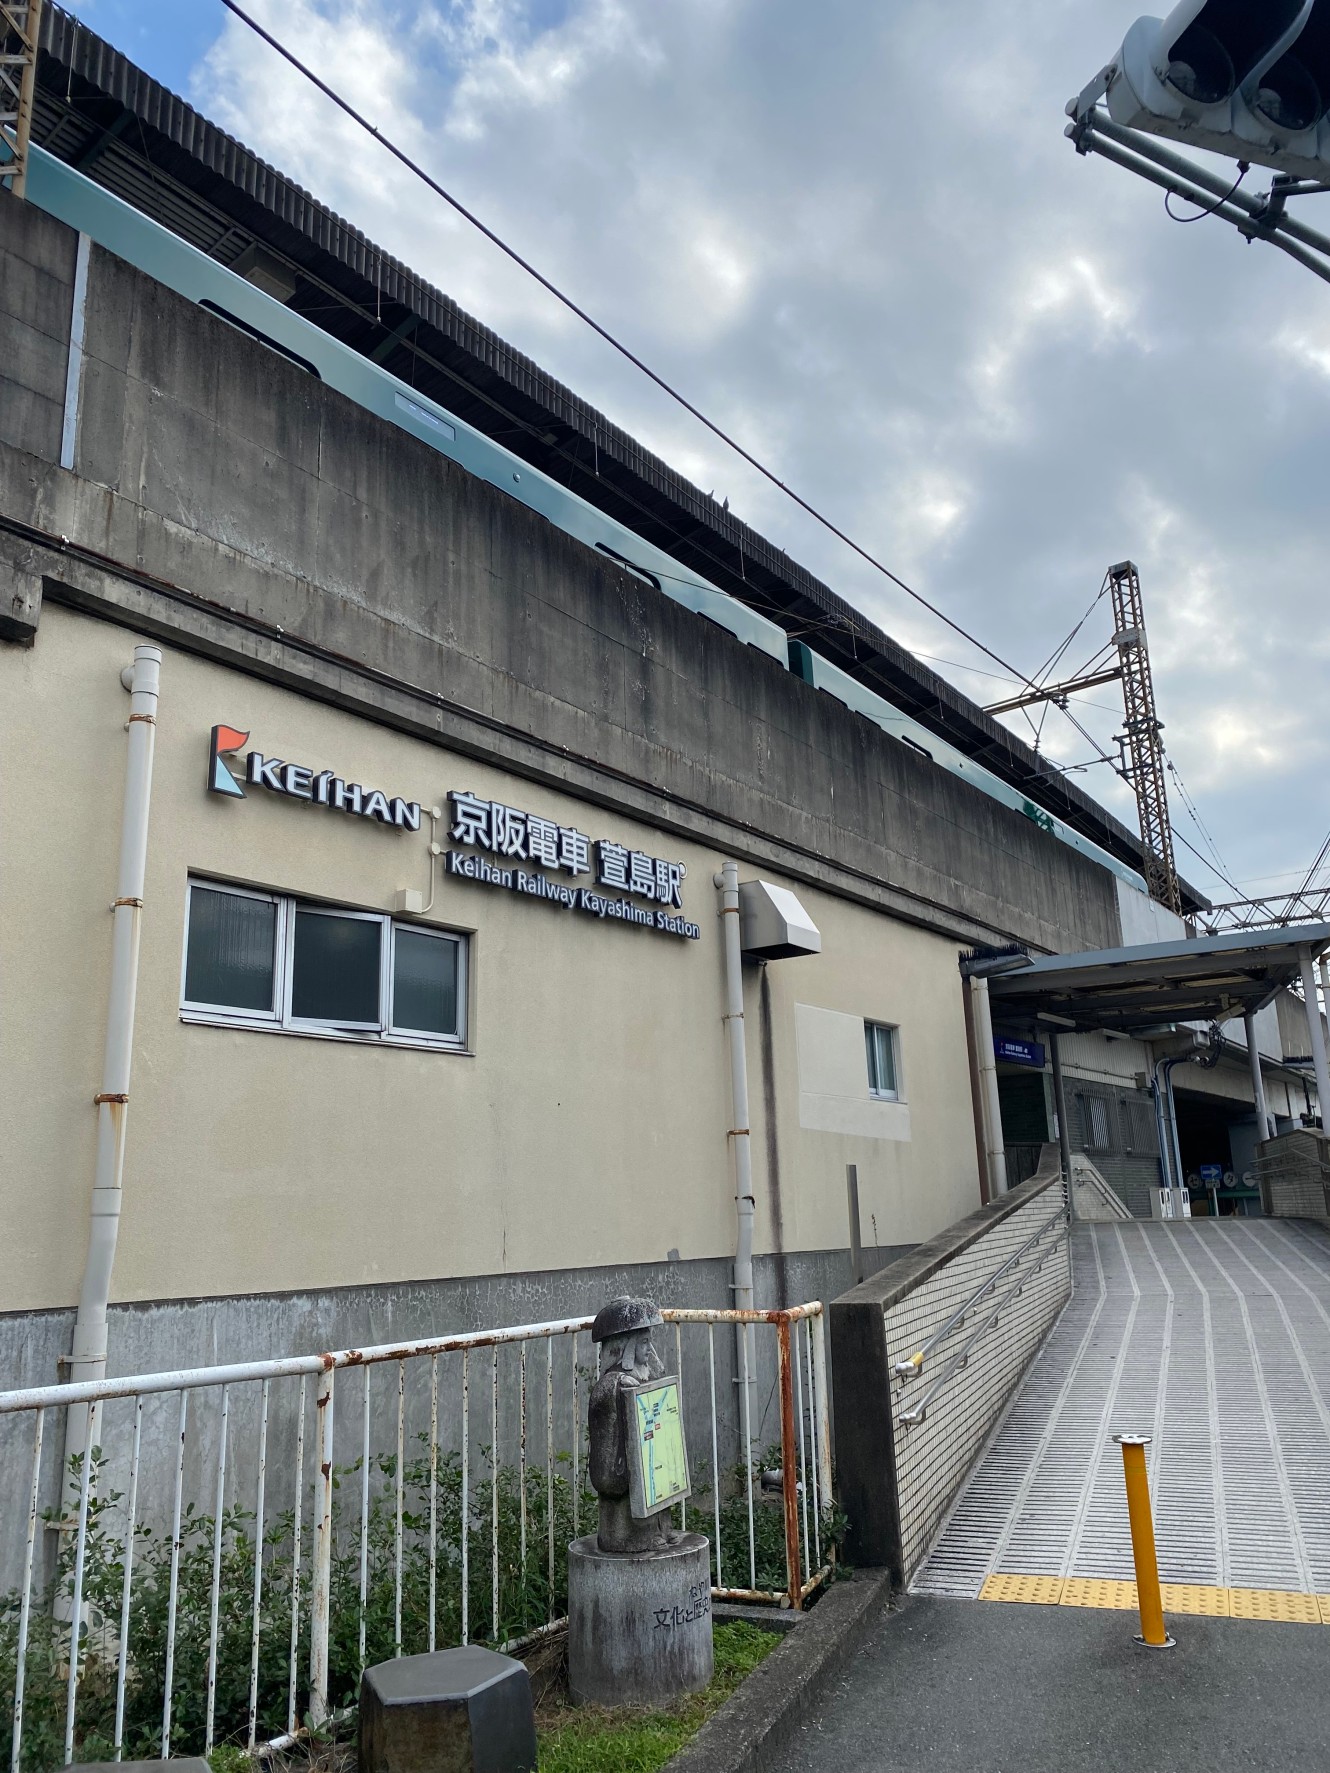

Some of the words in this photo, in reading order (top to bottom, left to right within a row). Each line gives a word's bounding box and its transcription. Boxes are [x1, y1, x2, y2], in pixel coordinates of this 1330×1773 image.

[246, 751, 421, 832] KEIHAN
[447, 790, 591, 877] 京阪電車
[594, 839, 683, 909] 萱島駅
[447, 851, 513, 889] Keihan
[513, 869, 577, 909] Railway
[578, 887, 655, 927] Kayashima
[655, 911, 701, 940] Station
